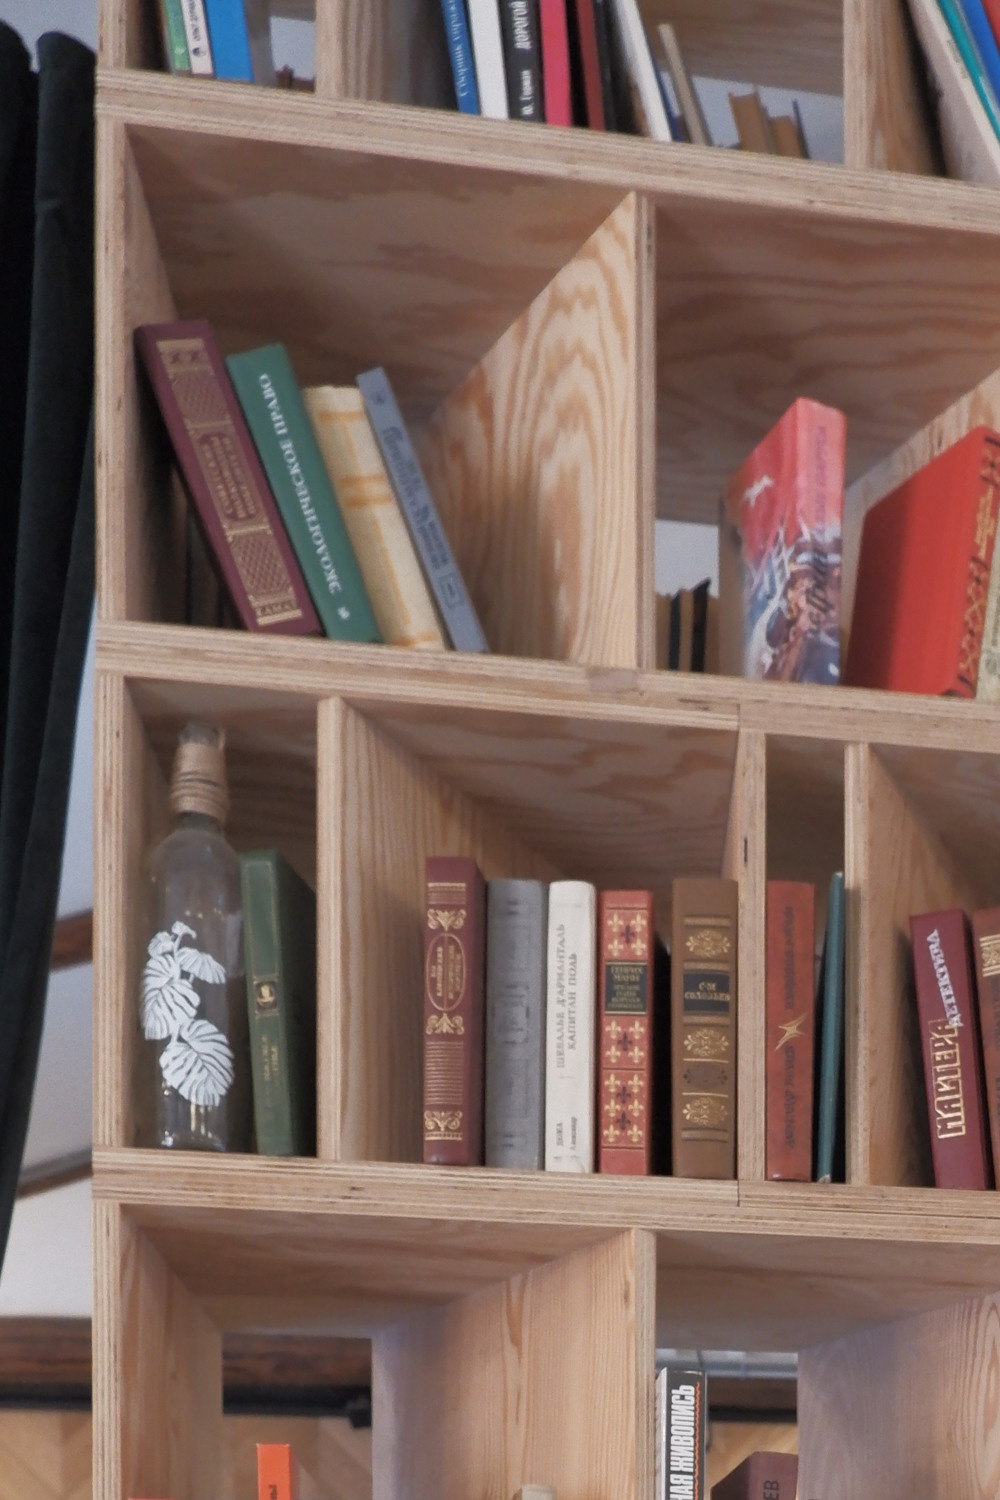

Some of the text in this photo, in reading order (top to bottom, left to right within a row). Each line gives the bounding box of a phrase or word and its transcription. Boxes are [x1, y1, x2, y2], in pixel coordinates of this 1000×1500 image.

[256, 372, 343, 595] ЭКОЛОГИЧЕСКОЕ ПРАВО
[567, 953, 577, 1050] КАПИТАН ПОЛЬ
[925, 926, 963, 1029] ДЕТЕКТИВА
[555, 1011, 565, 1067] ШЕВАЛЬЕ
[921, 1016, 971, 1139] МАСТЕРА
[669, 1384, 696, 1472] ЖИВОПИСЬ
